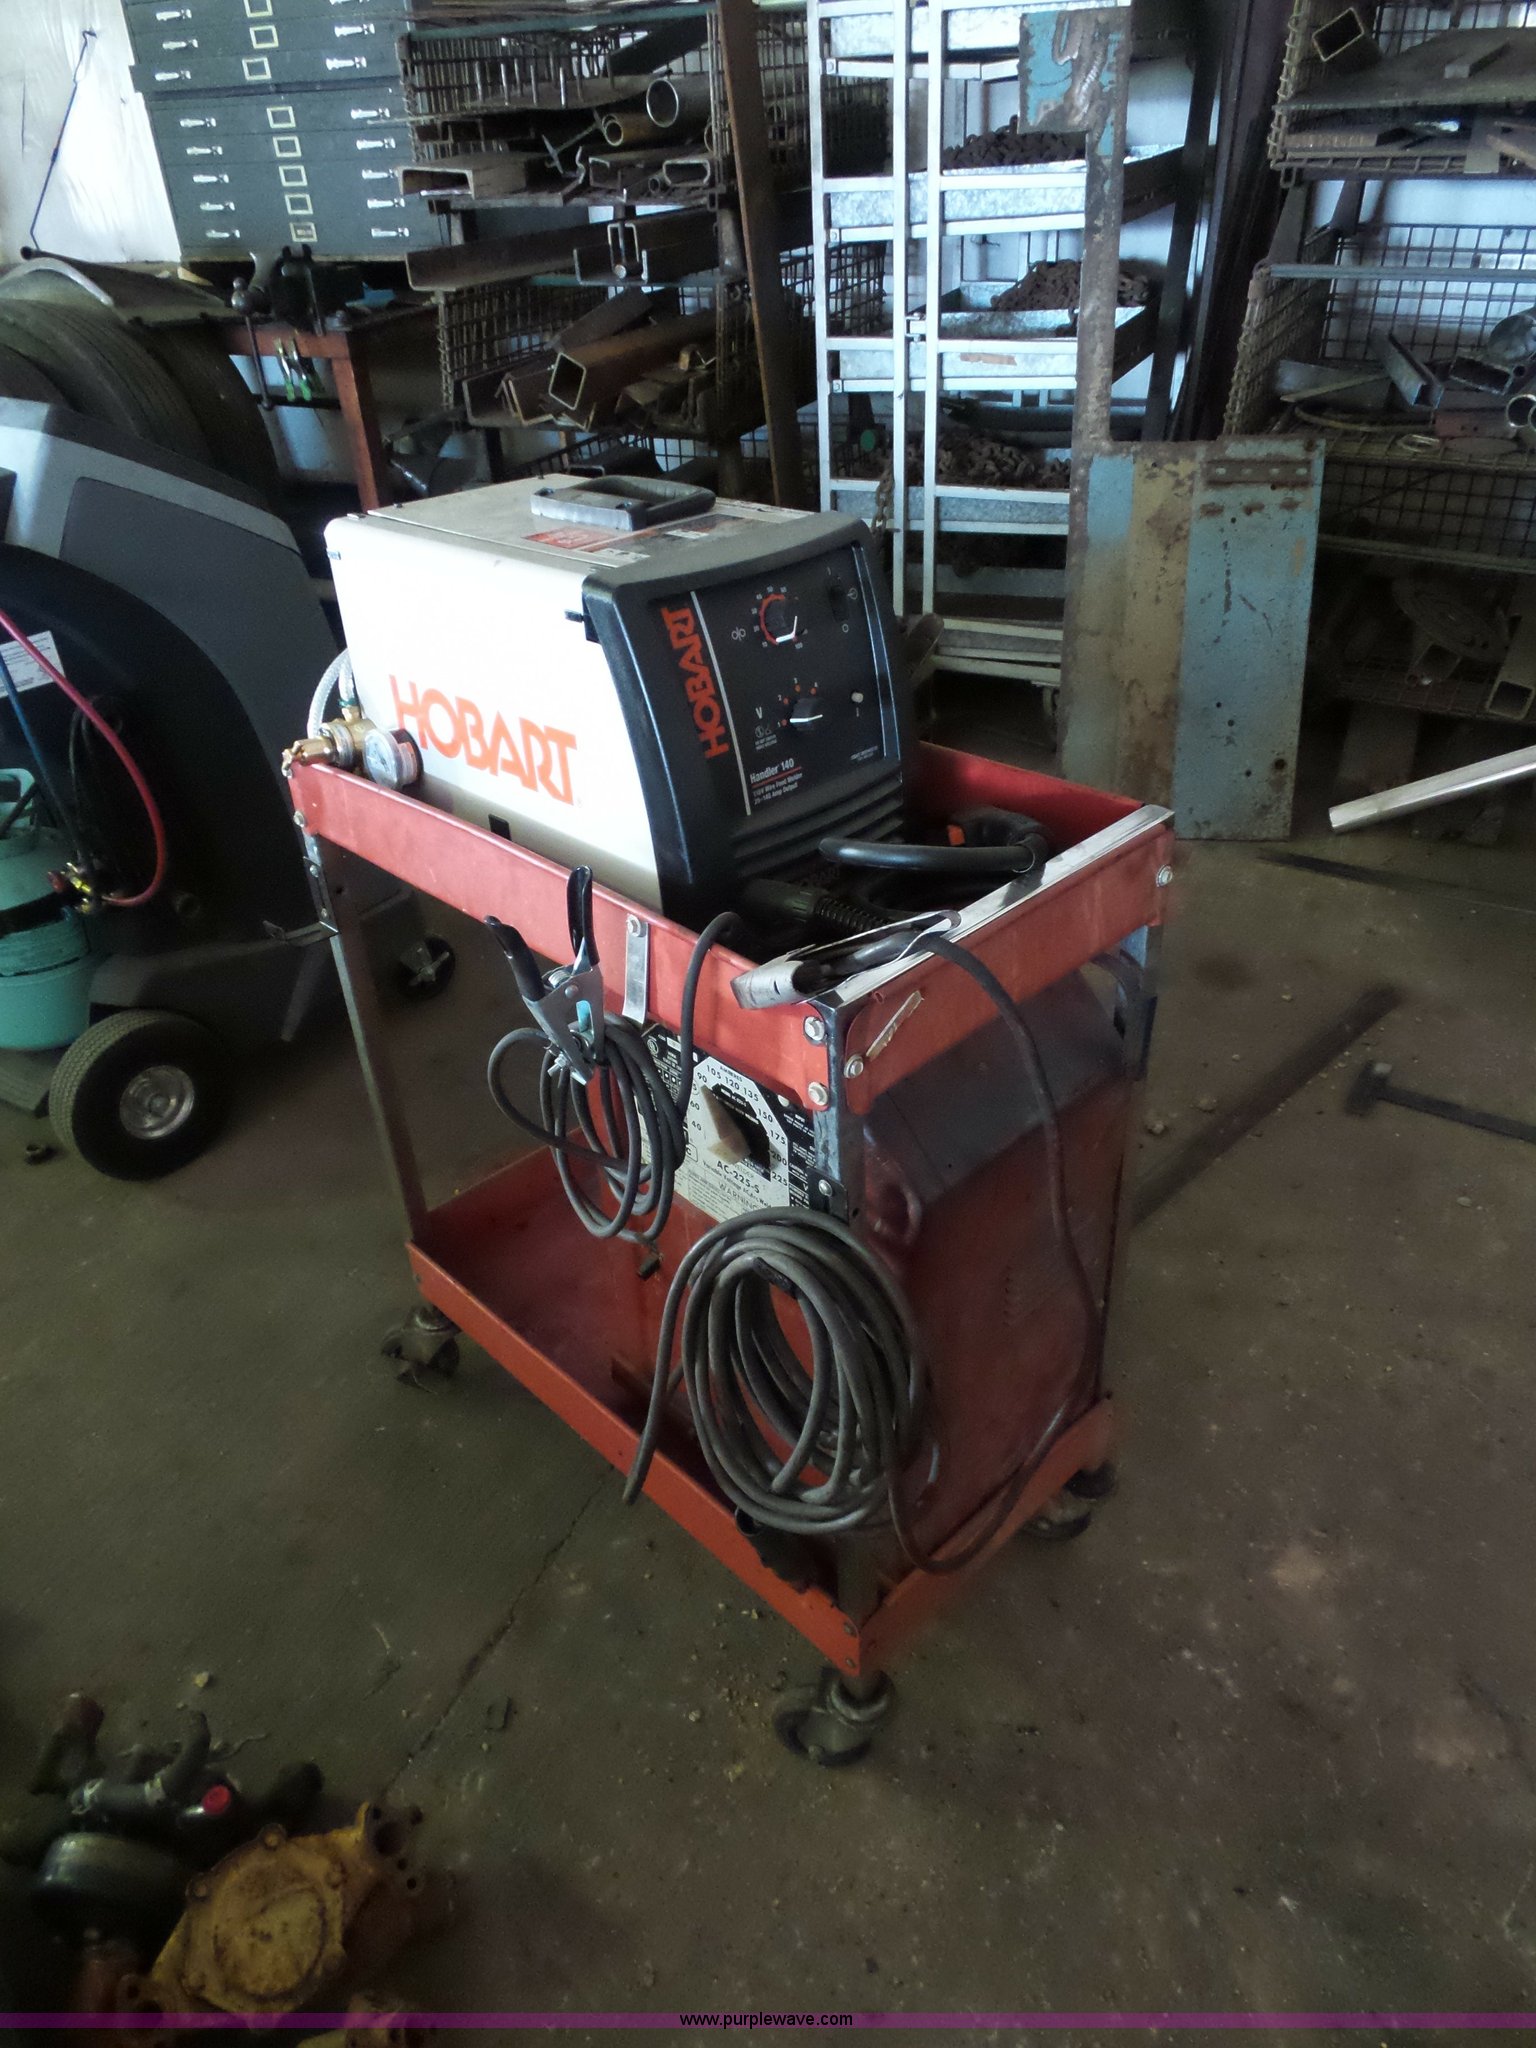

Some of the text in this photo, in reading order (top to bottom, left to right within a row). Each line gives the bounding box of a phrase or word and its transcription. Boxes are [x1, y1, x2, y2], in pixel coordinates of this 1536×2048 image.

[661, 607, 730, 759] HOBART
[755, 706, 763, 719] V
[389, 675, 577, 805] HOBART
[781, 758, 795, 771] 140
[697, 1072, 708, 1083] 90
[706, 1064, 722, 1079] 105
[725, 1076, 740, 1090] 120
[743, 1087, 759, 1102] 135
[690, 1100, 700, 1110] 60
[758, 1109, 774, 1123] 150
[691, 1121, 702, 1131] 40
[770, 1130, 786, 1145] 175
[771, 1150, 788, 1166] 200
[716, 1160, 760, 1194] AC-225-S
[772, 1171, 788, 1187] 225
